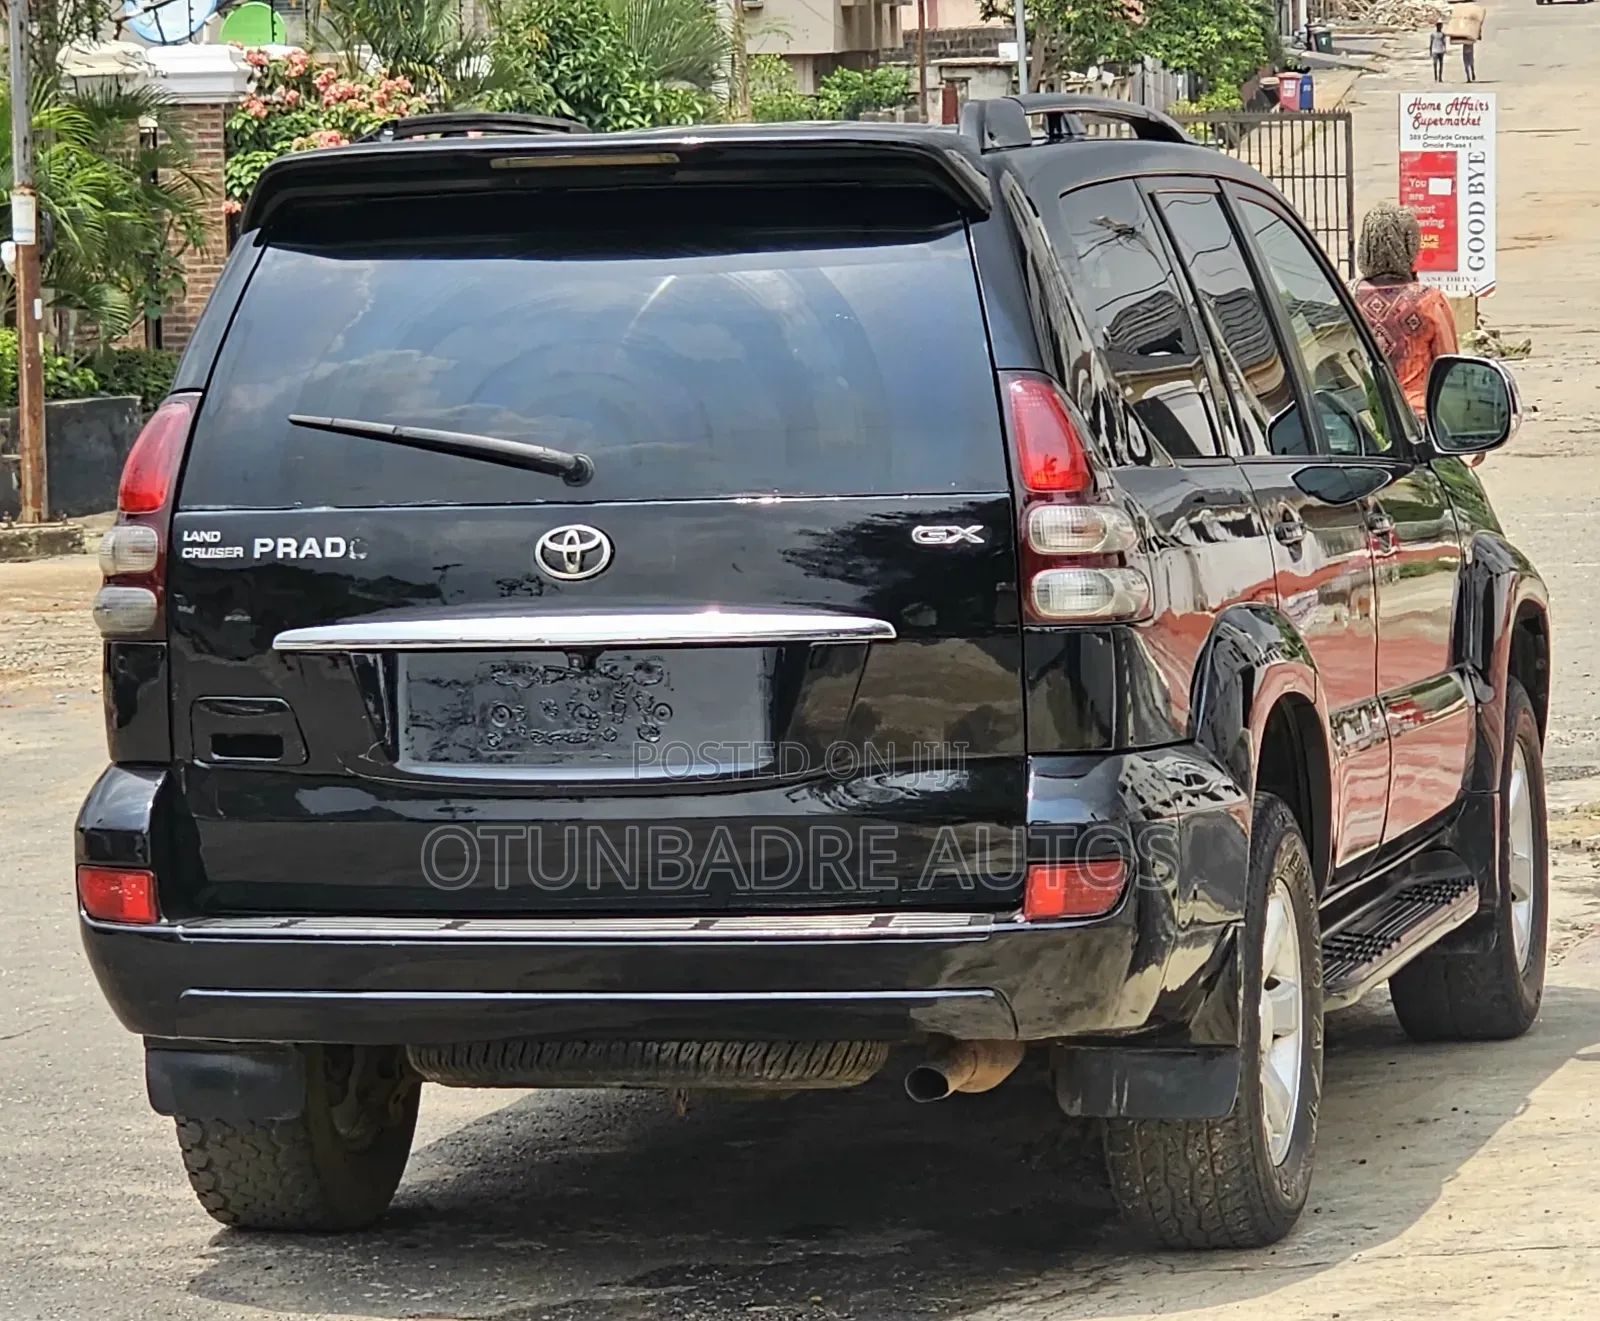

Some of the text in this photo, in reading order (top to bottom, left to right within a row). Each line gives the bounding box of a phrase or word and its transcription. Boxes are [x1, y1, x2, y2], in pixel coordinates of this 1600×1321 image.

[1407, 96, 1489, 115] Home Affairs
[1412, 112, 1481, 132] Supermarket
[1408, 178, 1427, 188] You
[183, 531, 221, 542] LAND
[912, 525, 985, 544] GX
[182, 547, 244, 558] CRUISER
